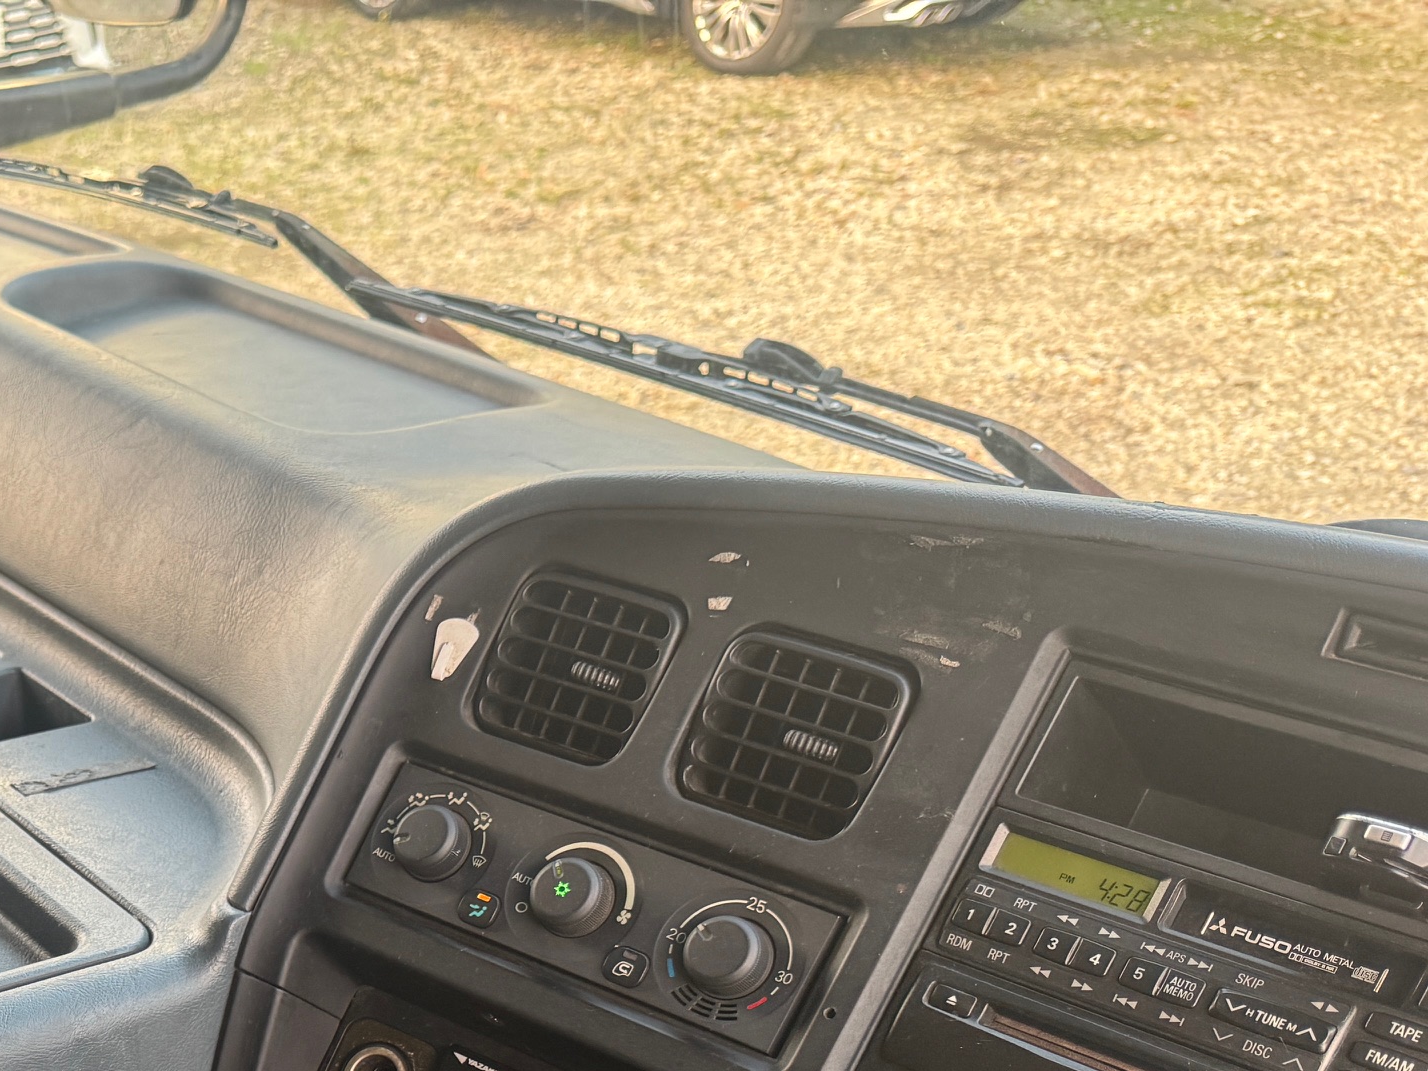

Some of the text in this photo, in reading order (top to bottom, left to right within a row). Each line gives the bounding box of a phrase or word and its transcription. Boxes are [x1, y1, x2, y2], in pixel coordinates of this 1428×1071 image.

[372, 847, 396, 862] AUTO
[1059, 873, 1152, 912] PM 4:28
[746, 897, 767, 914] 25
[1013, 897, 1037, 912] RPT
[666, 927, 687, 943] 20
[946, 933, 973, 951] RDM
[1230, 925, 1292, 955] FUSO
[966, 909, 1146, 980] 1 2 3 4 5
[987, 948, 1011, 964] RPT
[1166, 950, 1187, 963] APS
[1292, 943, 1354, 969] AUTO METAL
[774, 970, 793, 985] 30
[1170, 976, 1197, 992] AUTO
[1235, 973, 1265, 989] SKIP
[1163, 985, 1194, 1001] MEMO
[1245, 1008, 1255, 1018] H
[1254, 1010, 1287, 1031] TUNE
[1389, 1021, 1424, 1043] TAPE
[1242, 1039, 1273, 1059] DISC
